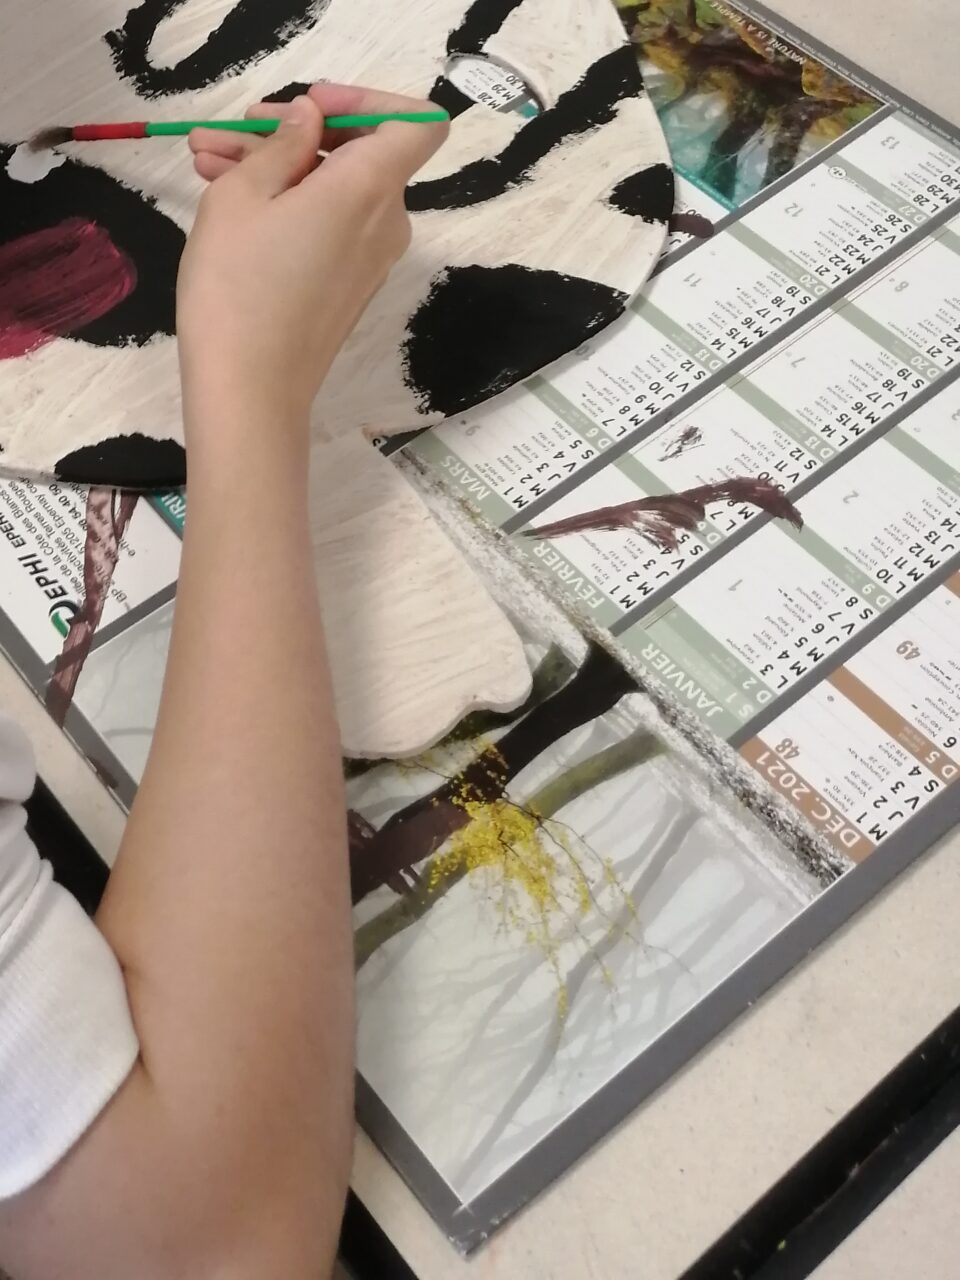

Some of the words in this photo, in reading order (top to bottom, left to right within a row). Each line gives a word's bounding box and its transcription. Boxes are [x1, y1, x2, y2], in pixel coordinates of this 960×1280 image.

[711, 1, 744, 26] TEMPLE
[768, 37, 805, 65] NATURE
[490, 83, 507, 94] 29
[476, 91, 493, 103] 28
[501, 90, 515, 101] M
[486, 99, 501, 109] M
[939, 173, 958, 187] 30
[926, 183, 944, 196] 29
[912, 193, 930, 206] 28
[939, 192, 955, 204] M
[930, 202, 940, 213] L
[884, 213, 903, 226] 26
[870, 223, 888, 236] 25
[899, 223, 912, 233] S
[856, 233, 875, 246] 24
[883, 234, 896, 244] V
[841, 243, 860, 256] 23
[870, 244, 884, 252] J
[827, 253, 846, 267] 22
[855, 252, 871, 265] M
[814, 264, 831, 276] 21
[841, 263, 856, 275] M
[830, 273, 841, 284] L
[785, 285, 800, 298] 19
[770, 295, 785, 308] 18
[798, 295, 811, 305] S
[782, 306, 795, 317] V
[709, 337, 726, 351] 14
[939, 333, 959, 348] 22
[726, 347, 737, 359] L
[925, 344, 943, 358] 21
[679, 358, 695, 372] 12
[943, 355, 954, 366] L
[692, 370, 706, 380] S
[896, 367, 912, 381] 19
[881, 378, 897, 392] 18
[911, 378, 924, 389] S
[894, 390, 908, 402] V
[618, 404, 631, 415] 8
[601, 417, 615, 427] 7
[628, 413, 644, 426] M
[615, 425, 627, 437] L
[819, 423, 837, 438] 14
[568, 439, 582, 449] 5
[837, 434, 849, 447] L
[552, 450, 565, 459] 4
[580, 449, 594, 459] S
[788, 446, 805, 461] 12
[535, 462, 549, 473] 3
[562, 461, 577, 473] V
[803, 459, 817, 470] S
[441, 455, 492, 500] MARS
[519, 473, 533, 484] 2
[546, 472, 561, 481] J
[48, 480, 60, 496] 50
[502, 486, 514, 496] 1
[528, 482, 546, 496] M
[9, 480, 35, 512] Rouges
[57, 494, 70, 506] 40
[511, 494, 529, 508] M
[36, 494, 65, 528] Epernay
[67, 505, 81, 519] 54
[709, 510, 724, 520] 7
[21, 516, 37, 534] des
[32, 511, 56, 539] Terres
[725, 518, 737, 531] L
[939, 517, 957, 532] 14
[61, 527, 86, 555] 51205
[674, 533, 690, 544] 5
[923, 530, 941, 545] 13
[34, 533, 54, 556] Côte
[689, 544, 703, 556] S
[908, 541, 925, 558] 12
[939, 543, 955, 552] J
[51, 553, 62, 566] la
[642, 558, 656, 570] 3
[892, 555, 908, 569] 11
[922, 553, 940, 569] M
[59, 563, 72, 576] de
[532, 541, 606, 608] FÉVRIER
[625, 570, 640, 582] 2
[654, 570, 670, 579] J
[875, 568, 893, 584] 10
[906, 566, 924, 582] M
[608, 584, 620, 595] 1
[636, 580, 654, 596] M
[895, 580, 906, 594] L
[110, 588, 127, 603] BP
[618, 593, 637, 609] M
[844, 596, 858, 607] 8
[826, 611, 842, 622] 7
[858, 607, 873, 620] S
[810, 622, 825, 634] 6
[840, 622, 855, 635] V
[793, 636, 808, 648] 5
[824, 635, 840, 644] J
[776, 649, 790, 659] 4
[806, 646, 824, 662] M
[895, 639, 921, 660] 49
[759, 663, 774, 676] 3
[788, 660, 807, 676] M
[640, 642, 724, 717] JANVIER
[776, 674, 788, 689] L
[774, 737, 800, 760] 48
[942, 736, 957, 748] 6
[924, 750, 940, 764] 5
[756, 751, 810, 799] 2021
[907, 765, 922, 776] 4
[941, 764, 958, 779] D
[889, 780, 905, 794] 3
[923, 778, 939, 793] S
[872, 794, 888, 809] 2
[903, 795, 920, 810] V
[855, 811, 867, 824] 1
[887, 810, 904, 820] J
[811, 798, 861, 848] DÉC.
[867, 823, 888, 841] M
